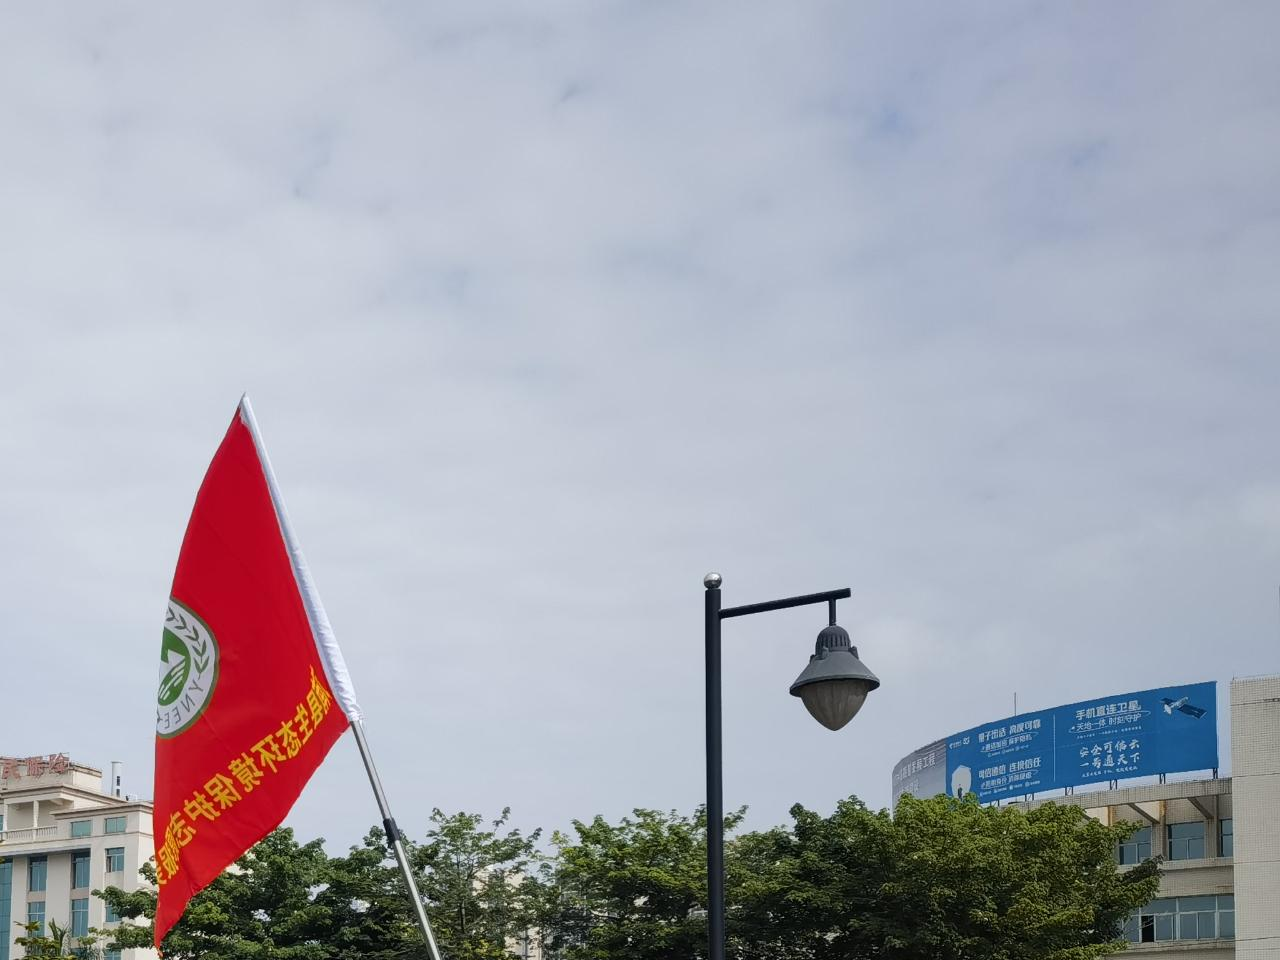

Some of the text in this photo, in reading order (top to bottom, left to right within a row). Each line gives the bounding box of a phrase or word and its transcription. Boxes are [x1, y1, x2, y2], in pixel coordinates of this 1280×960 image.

[1076, 700, 1141, 720] 手机直连卫星
